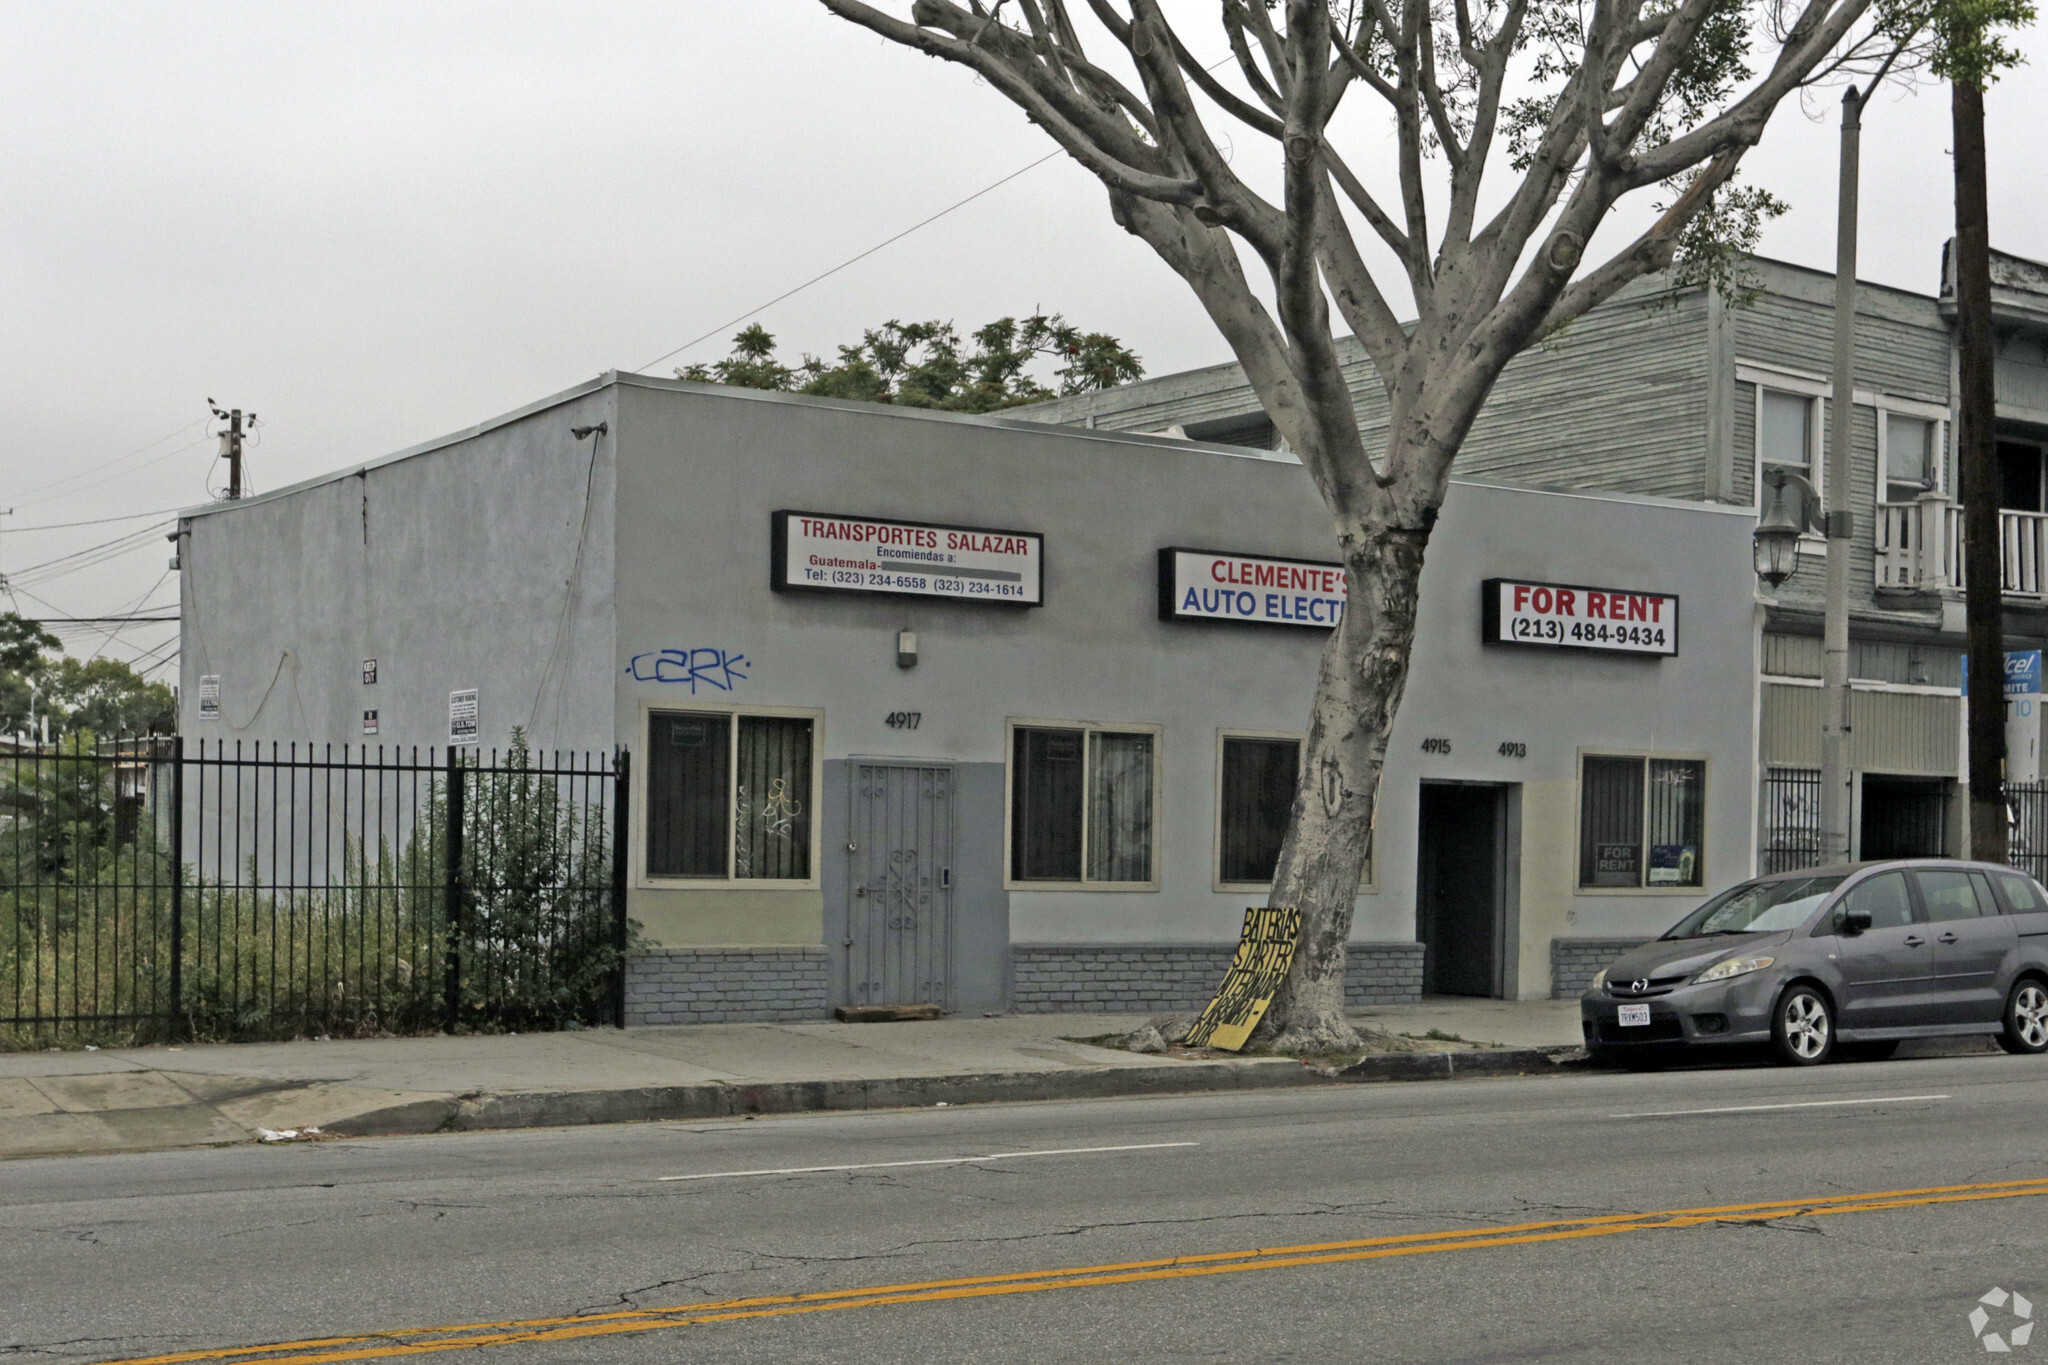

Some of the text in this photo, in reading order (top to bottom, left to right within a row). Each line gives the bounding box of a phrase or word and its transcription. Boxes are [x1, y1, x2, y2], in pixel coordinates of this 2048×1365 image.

[801, 519, 1028, 556] TRANSPORTES SALAZAR
[876, 546, 957, 563] Encomiendas a:
[805, 568, 1024, 597] Tel: (323) 234-6558 (323) 234-1614
[1182, 586, 1256, 616] AUTO
[1513, 585, 1664, 623] FOR RENT
[1511, 618, 1666, 646] (213) 484-9434
[364, 671, 375, 684] OUT
[885, 711, 922, 729] 4917
[1421, 738, 1451, 755] 4915
[1497, 742, 1527, 758] 4913
[1604, 847, 1632, 859] FOR
[1599, 859, 1636, 871] RENT
[1233, 940, 1293, 974] STARTER
